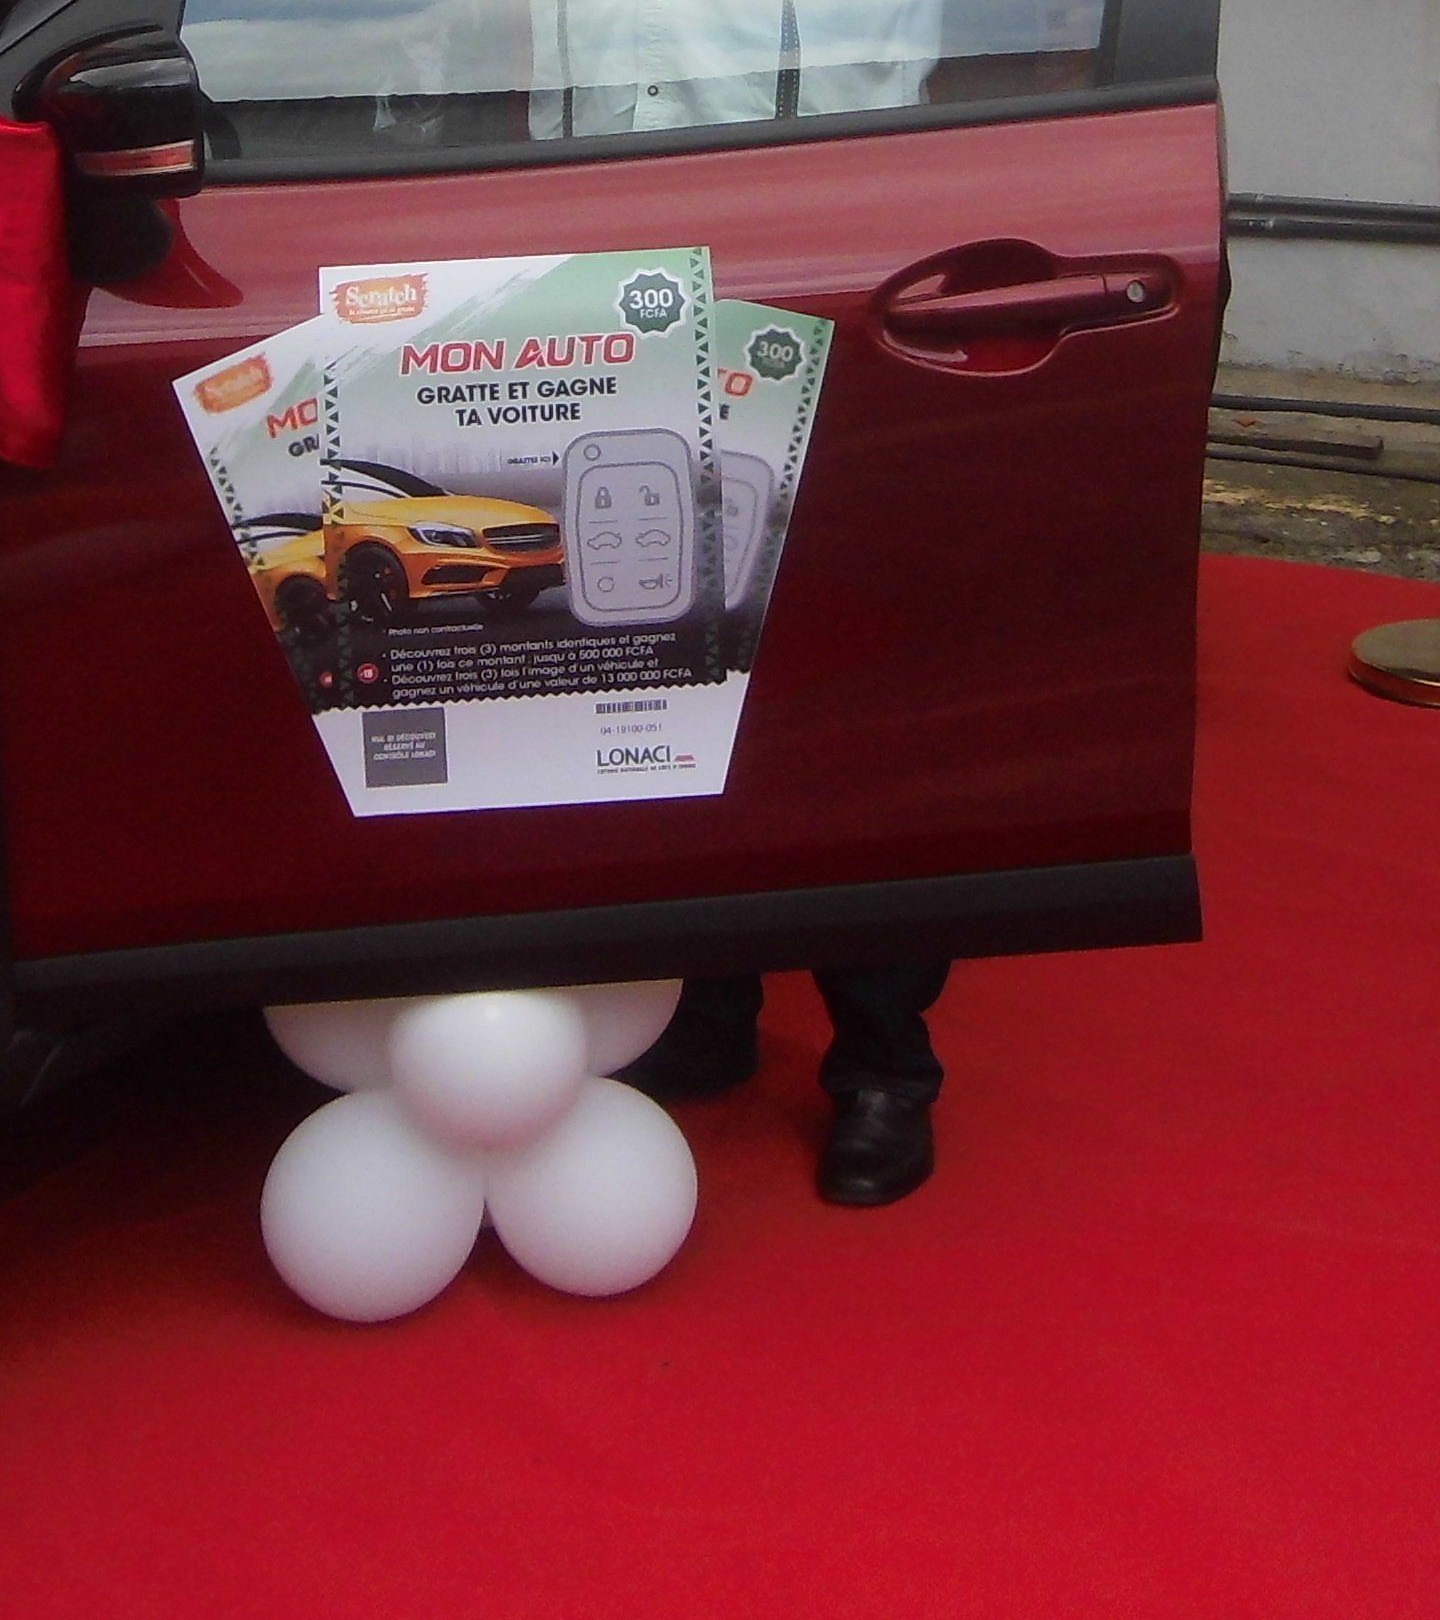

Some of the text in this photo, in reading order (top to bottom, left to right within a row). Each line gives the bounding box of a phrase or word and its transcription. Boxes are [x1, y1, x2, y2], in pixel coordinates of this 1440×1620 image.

[345, 284, 417, 308] Scratch
[629, 288, 673, 309] 300
[639, 308, 668, 319] FCFA
[400, 333, 635, 375] MON AUTO
[757, 341, 794, 362] 300
[416, 376, 618, 405] GRATTE ET GAGNE
[455, 402, 582, 427] TA VOITURE
[390, 648, 451, 660] Découvrez
[480, 644, 497, 656] (3)
[500, 639, 554, 653] montants
[557, 635, 616, 649] identiques
[633, 632, 676, 646] gagnez
[391, 663, 414, 673] une
[417, 660, 434, 673] (1)
[458, 658, 474, 668] ce
[602, 646, 624, 659] 000
[625, 645, 654, 656] FCFA
[392, 672, 452, 685] Découvrez
[455, 670, 478, 681] trois
[481, 668, 498, 681] (3)
[597, 658, 645, 672] véhicule
[392, 687, 437, 700] gagnez
[439, 686, 454, 695] un
[457, 680, 505, 694] véhicule
[544, 677, 580, 688] valeur
[582, 675, 598, 685] de
[601, 673, 615, 684] 13
[616, 671, 638, 683] 000
[639, 669, 661, 681] 000
[663, 667, 692, 679] FCFA
[596, 745, 671, 767] LONACI
